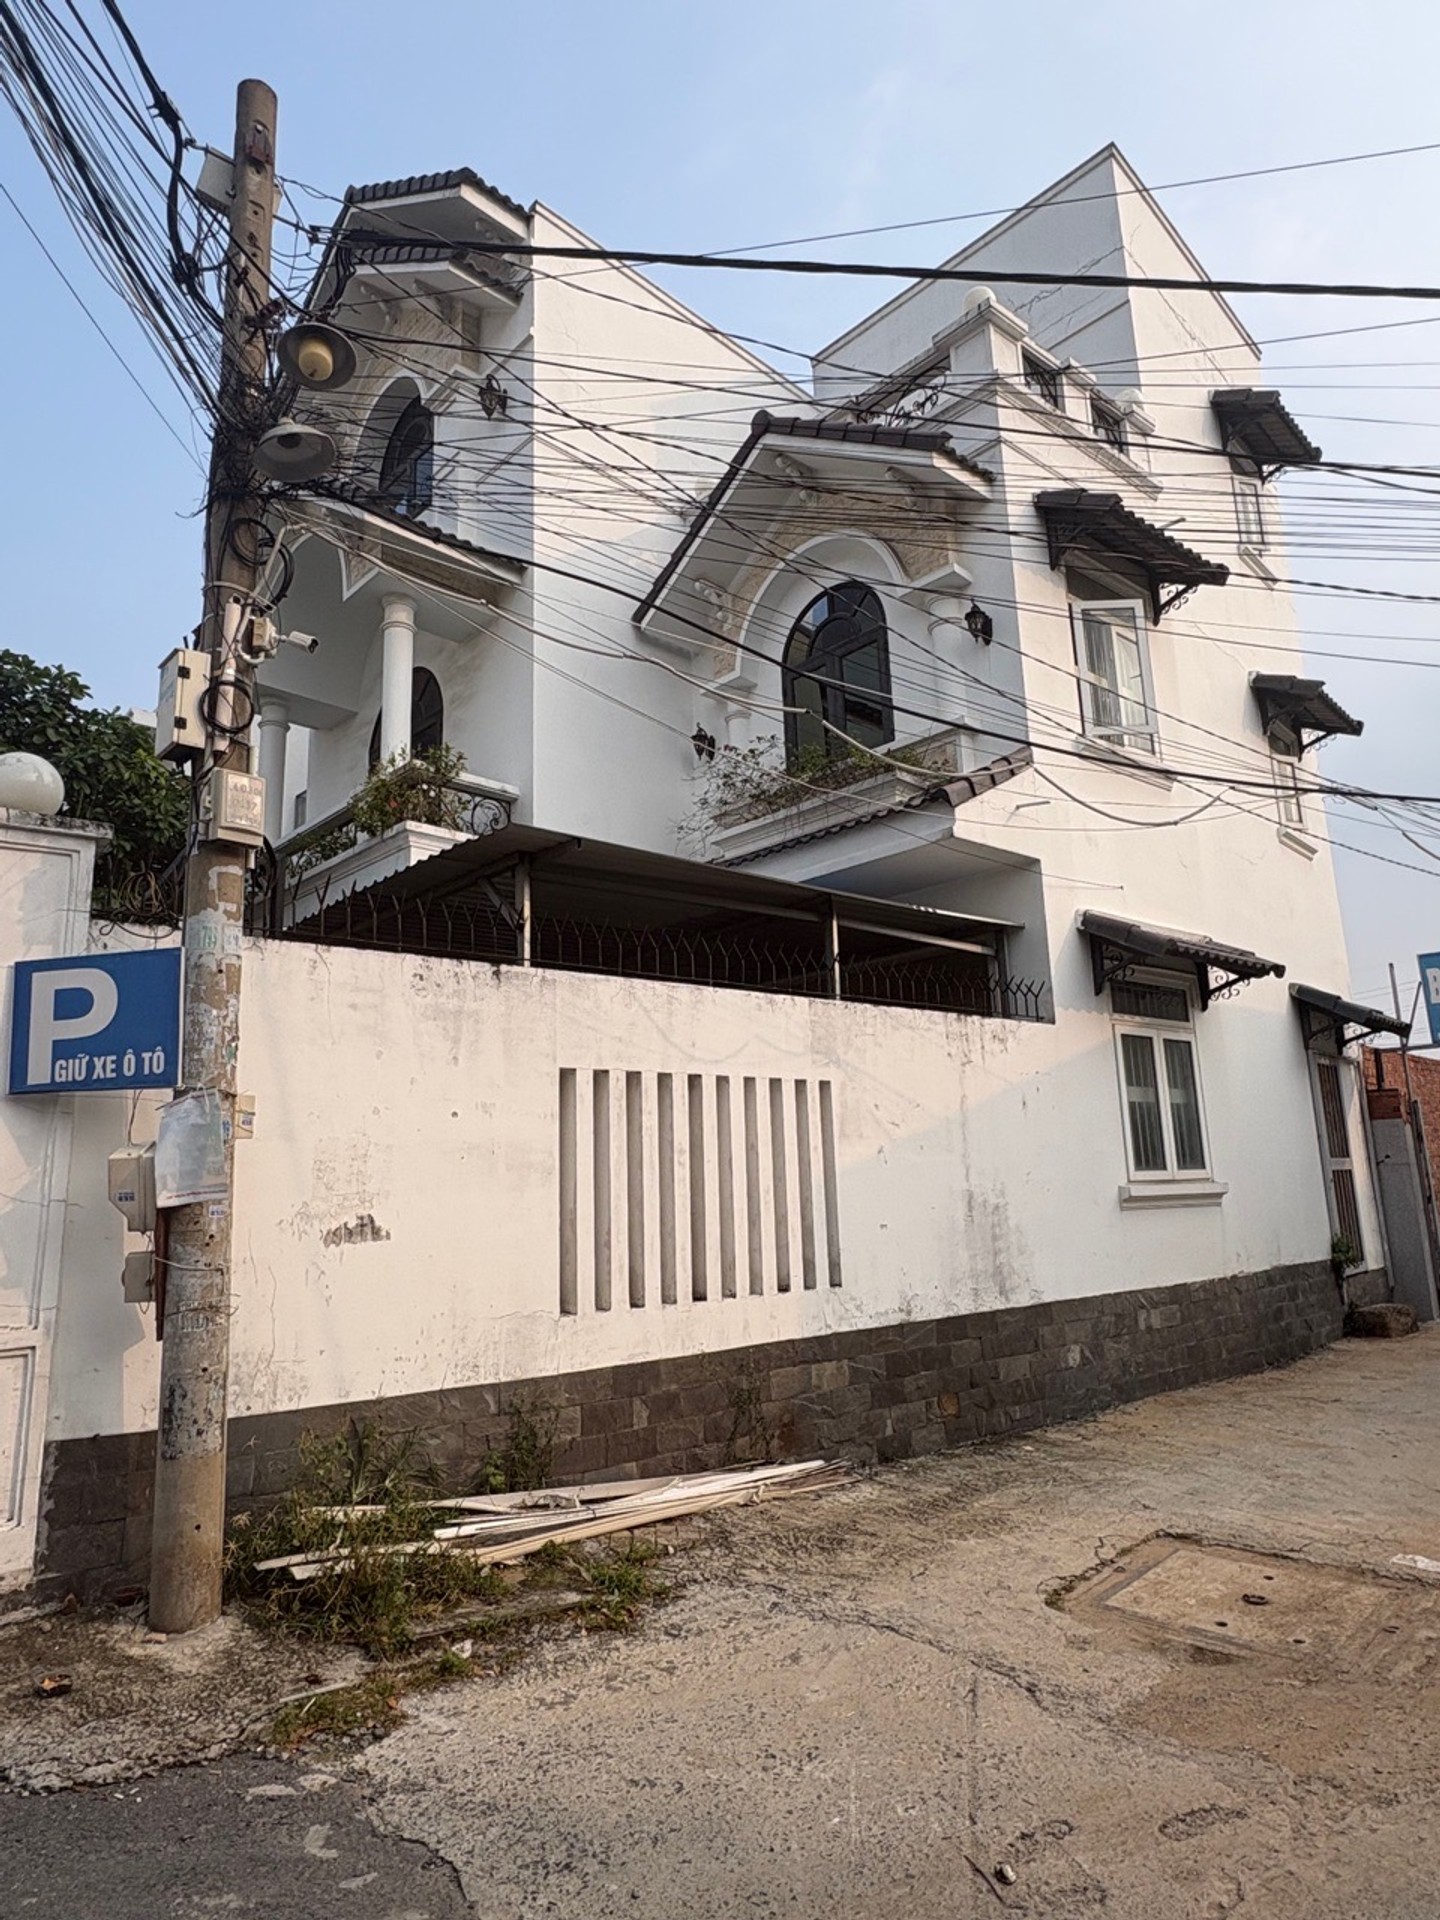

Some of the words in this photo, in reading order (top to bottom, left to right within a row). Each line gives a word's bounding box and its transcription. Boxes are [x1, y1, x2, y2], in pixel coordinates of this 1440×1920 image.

[27, 968, 118, 1085] P
[54, 1053, 90, 1083] GIỮ
[91, 1055, 117, 1080] XE
[123, 1048, 136, 1077] Ô
[141, 1046, 165, 1075] TÔ
